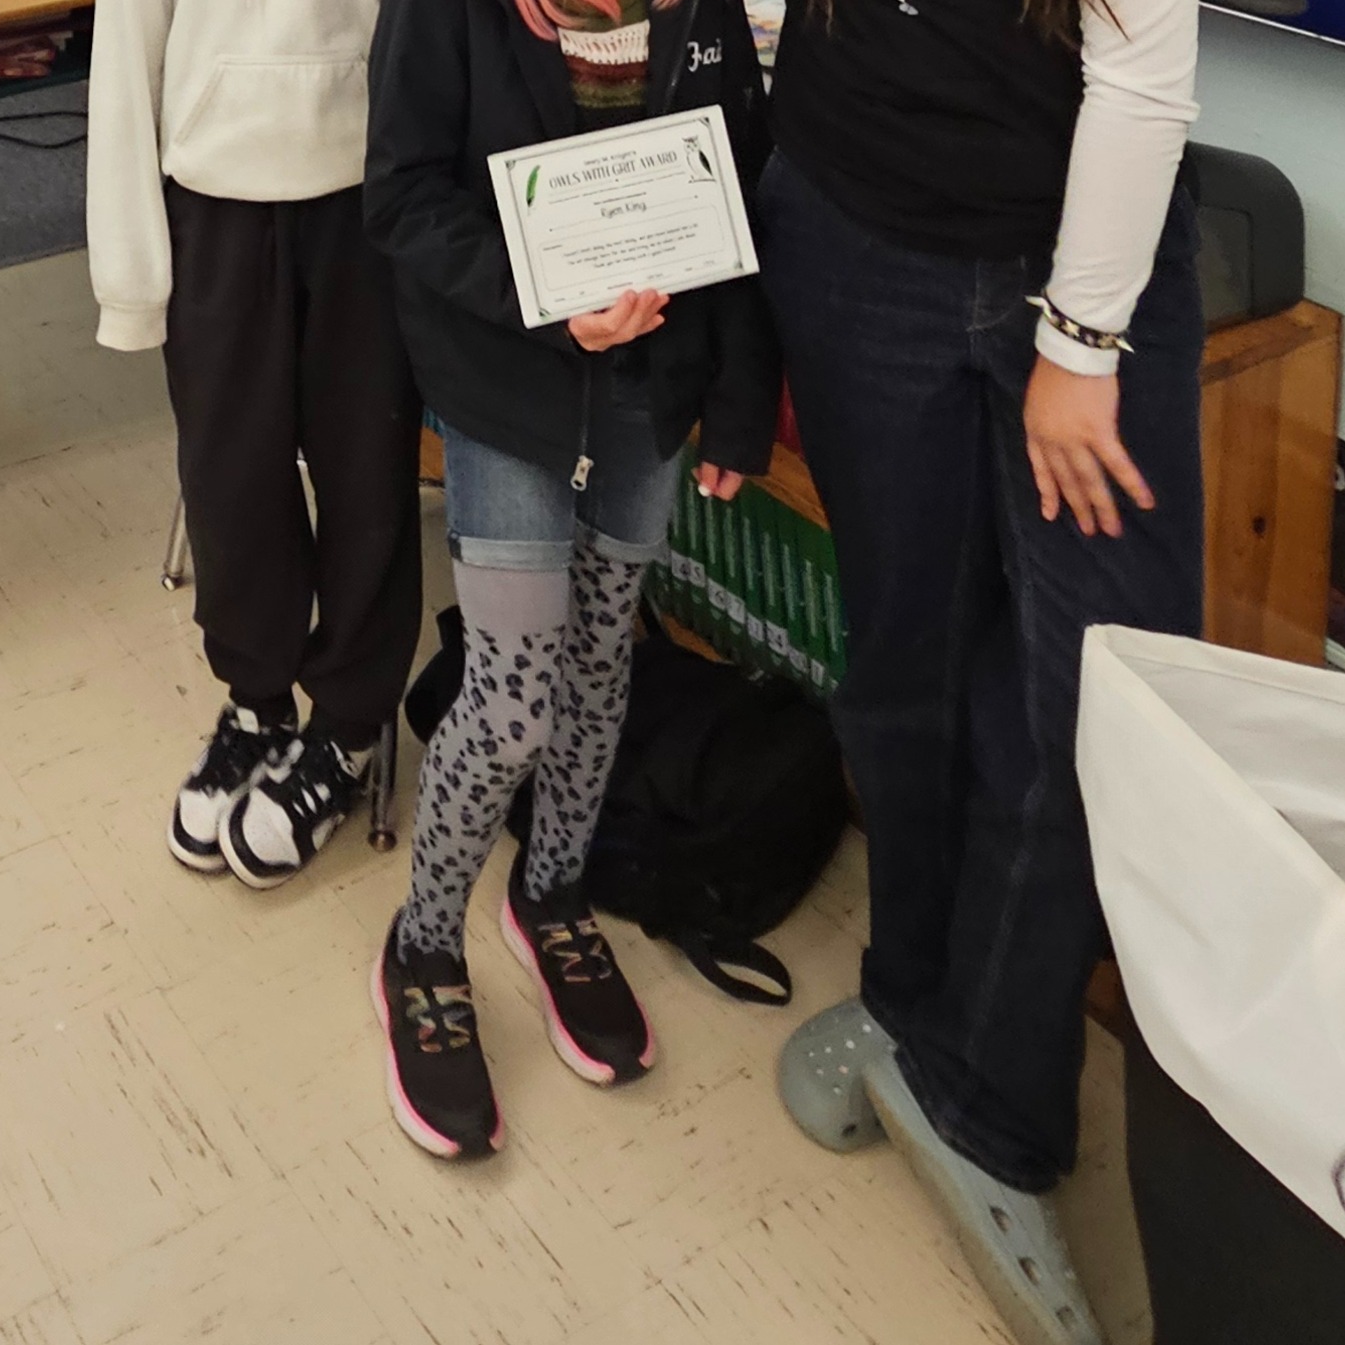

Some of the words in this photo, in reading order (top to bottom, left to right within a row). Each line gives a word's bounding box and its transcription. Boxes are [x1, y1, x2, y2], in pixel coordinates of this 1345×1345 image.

[549, 173, 580, 190] OWLS
[581, 164, 611, 182] WITH
[612, 159, 636, 176] GRIT
[640, 150, 678, 169] AWARD
[625, 201, 647, 212] King
